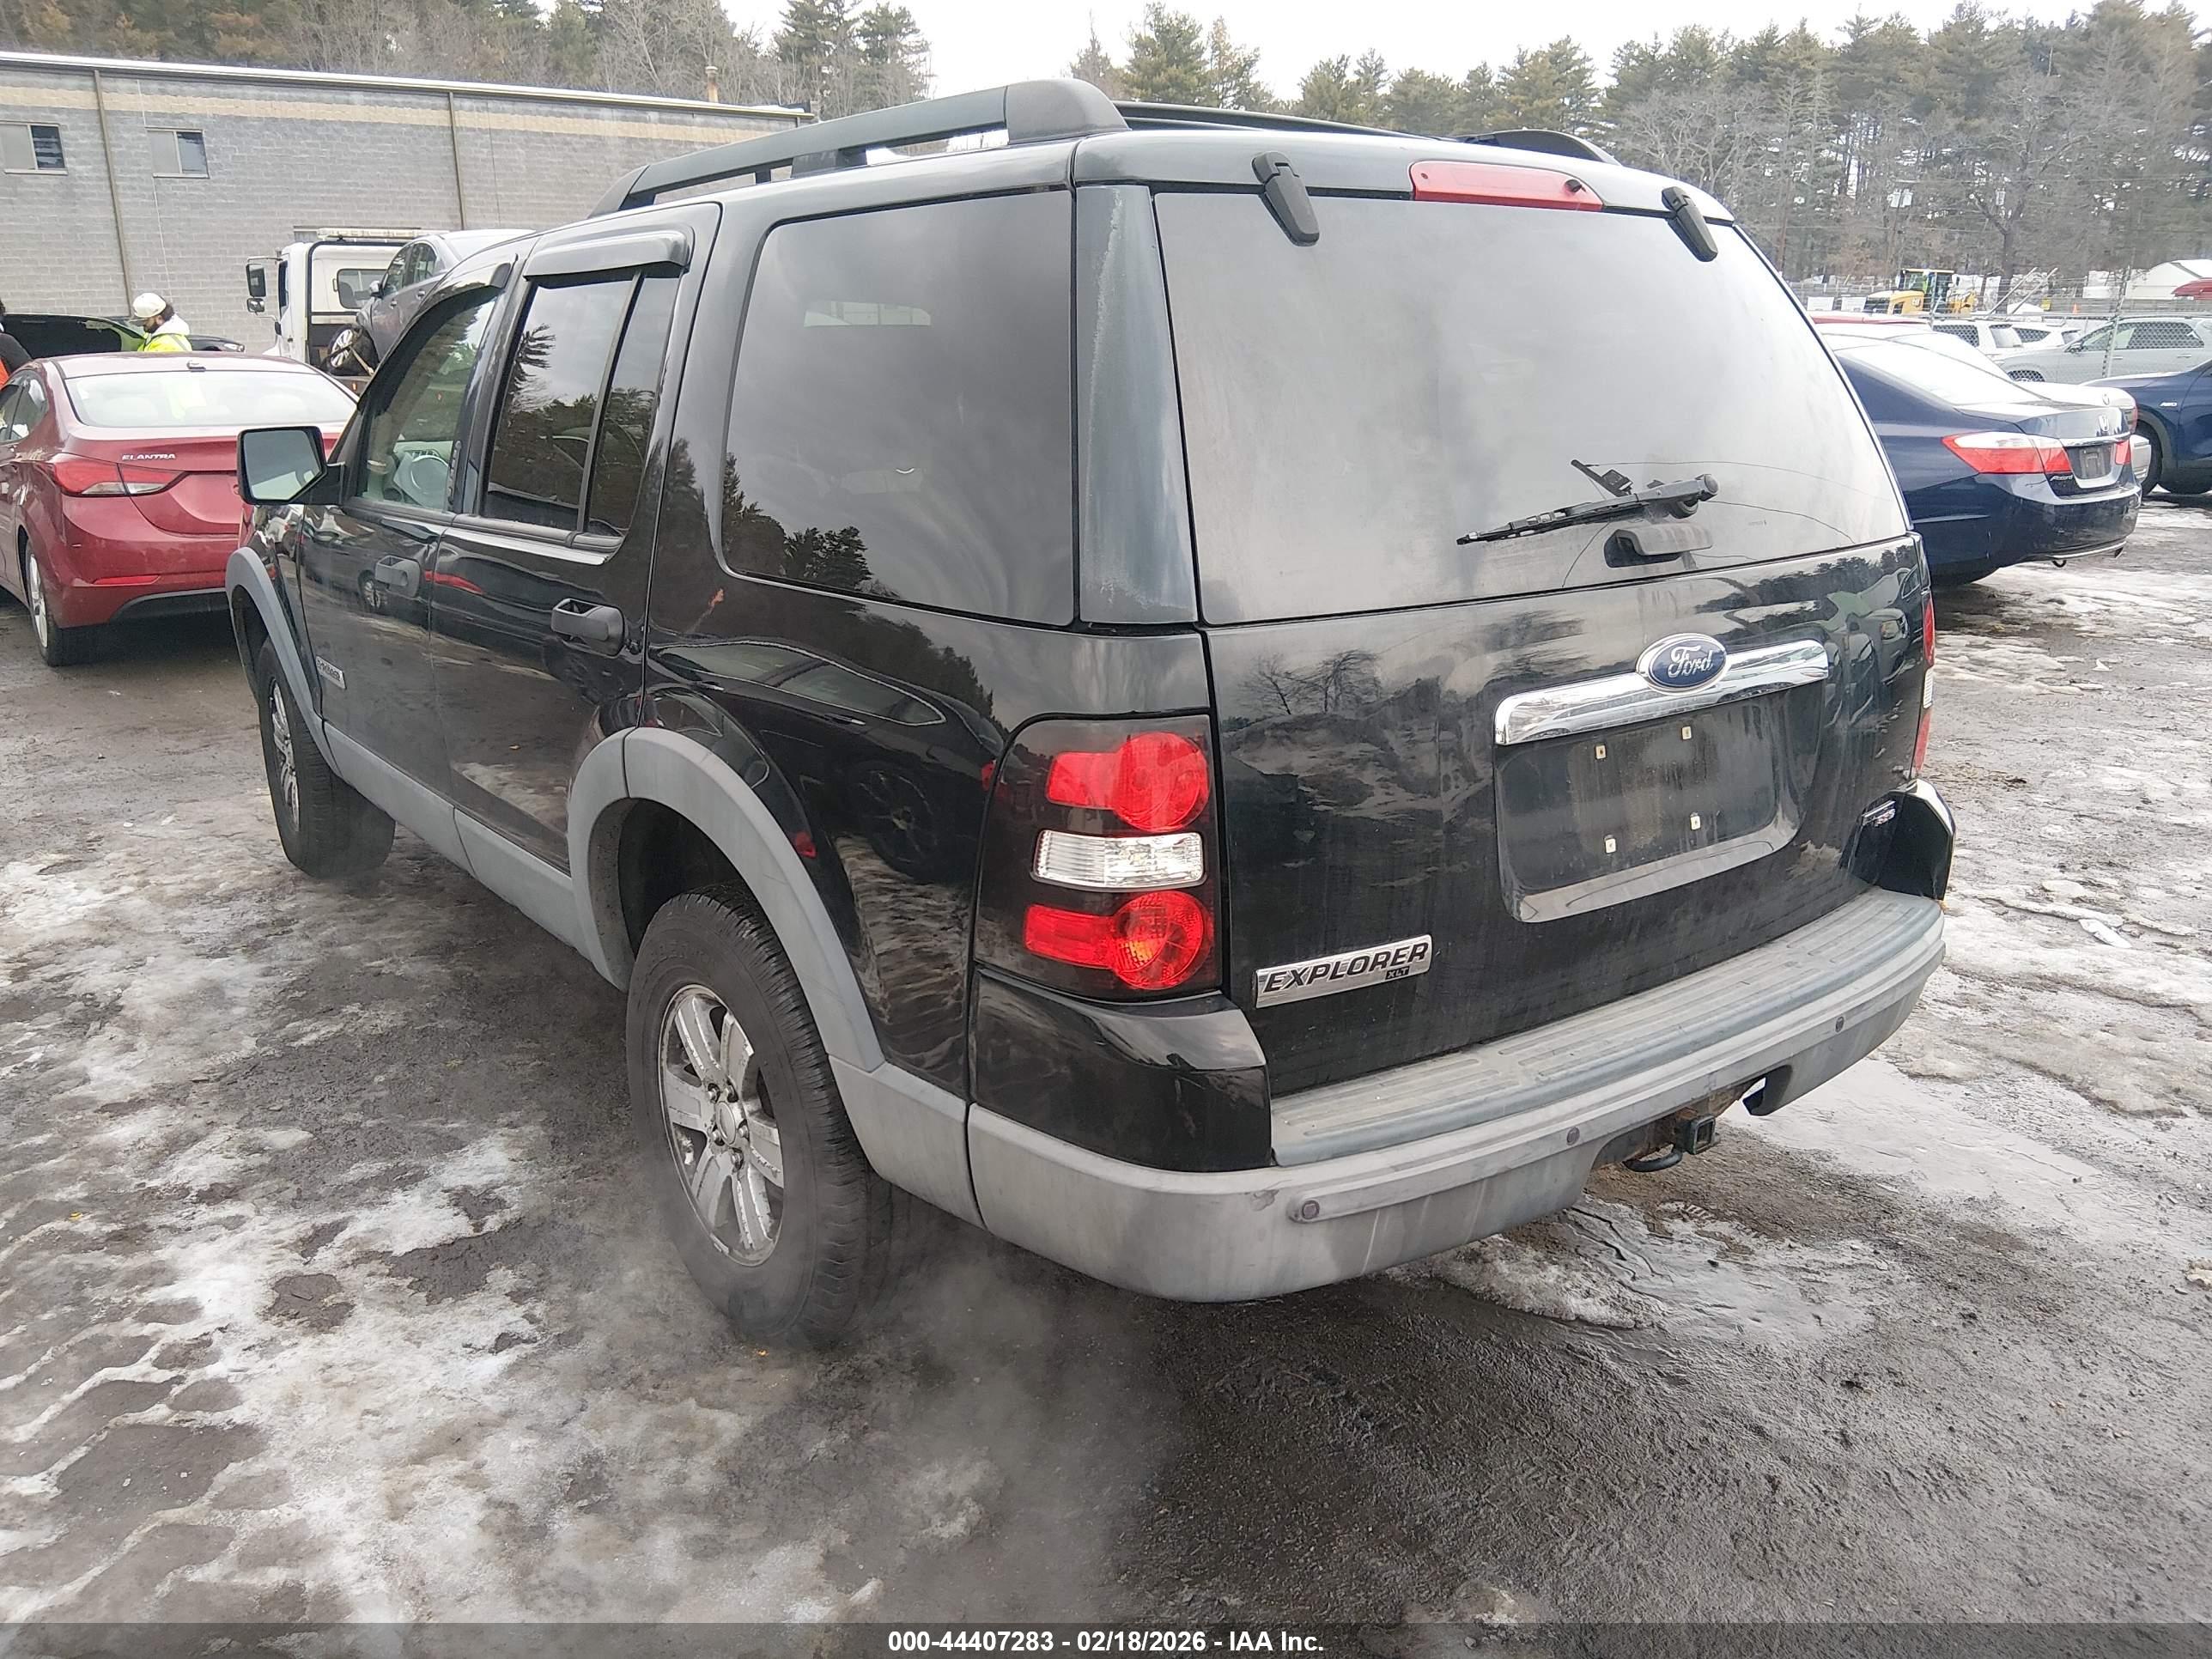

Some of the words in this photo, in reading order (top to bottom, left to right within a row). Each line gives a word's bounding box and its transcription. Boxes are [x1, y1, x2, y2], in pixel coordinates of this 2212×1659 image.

[1668, 645, 1714, 678] Ford
[1263, 942, 1429, 993] EXPLORER
[1387, 967, 1409, 979] XLT
